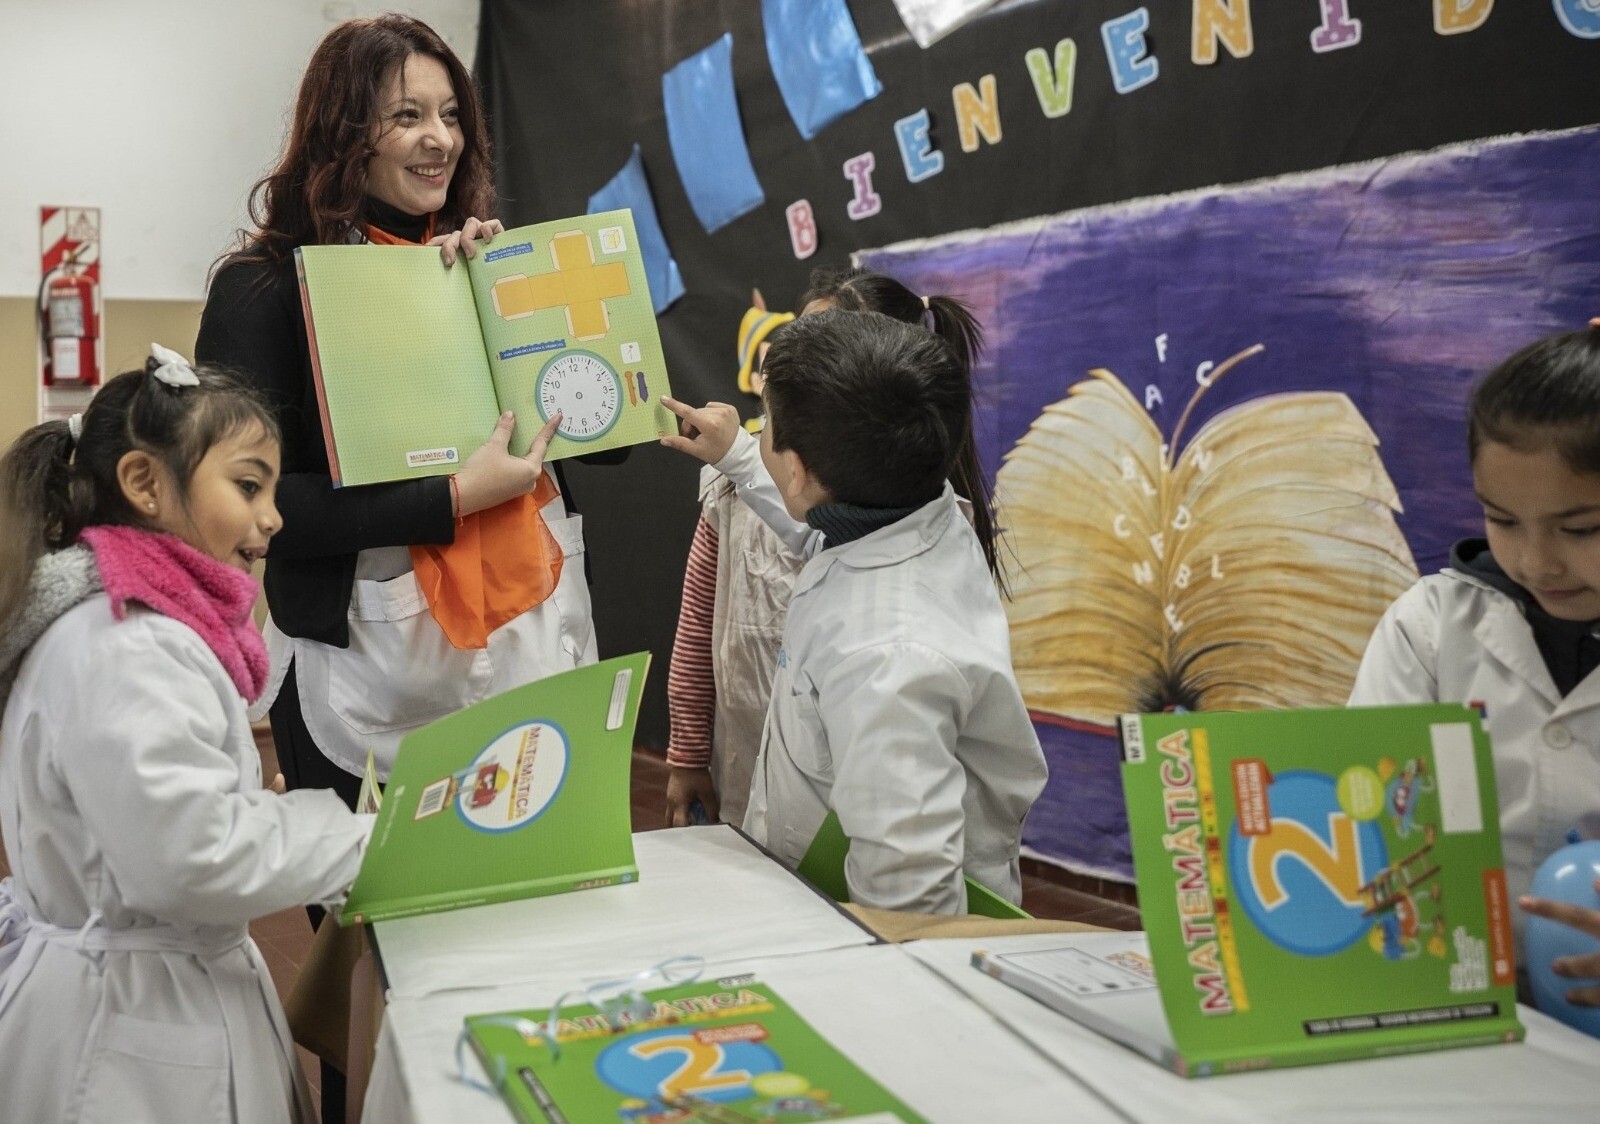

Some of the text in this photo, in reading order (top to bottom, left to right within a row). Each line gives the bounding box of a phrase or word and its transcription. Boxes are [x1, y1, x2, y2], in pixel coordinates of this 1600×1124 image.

[785, 0, 1600, 259] BIENVENI
[1155, 333, 1168, 363] F
[558, 370, 566, 379] 11
[568, 363, 579, 373] 12
[595, 373, 602, 382] 2
[1196, 361, 1214, 388] C
[550, 380, 561, 390] 10
[602, 385, 609, 395] 3
[1145, 384, 1163, 410] A
[549, 395, 556, 404] 9
[601, 400, 607, 408] 4
[567, 416, 573, 425] 7
[581, 417, 588, 427] 6
[595, 411, 601, 421] 5
[1113, 514, 1130, 538] C
[1171, 505, 1191, 530] D
[1175, 563, 1191, 589] B
[1211, 554, 1224, 578] L
[516, 725, 541, 818] MATEMÁTICA
[1157, 729, 1232, 1015] MATEMÁTICA
[1248, 812, 1367, 913] 2
[629, 1034, 752, 1099] 2
